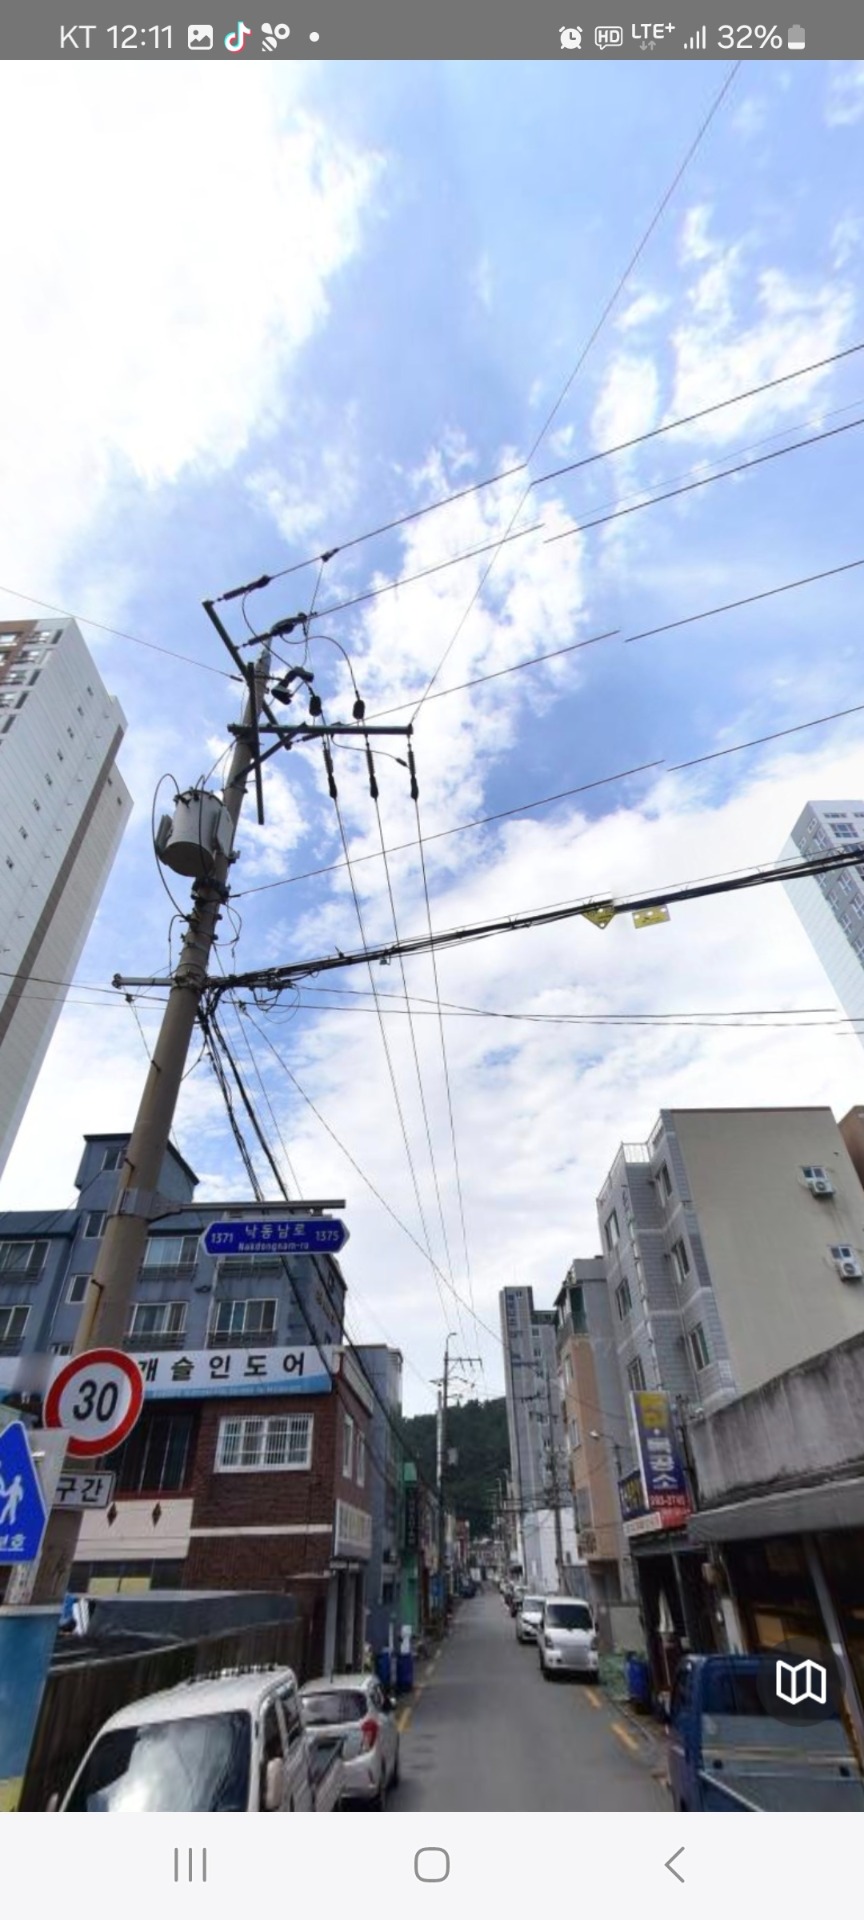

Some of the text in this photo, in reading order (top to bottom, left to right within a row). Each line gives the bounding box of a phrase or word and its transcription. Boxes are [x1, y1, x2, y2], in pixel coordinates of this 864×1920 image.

[211, 1232, 234, 1244] 1371
[245, 1223, 306, 1240] 낙동남로
[315, 1229, 340, 1242] 1375
[72, 1380, 119, 1422] 30
[56, 1477, 103, 1502] 구간
